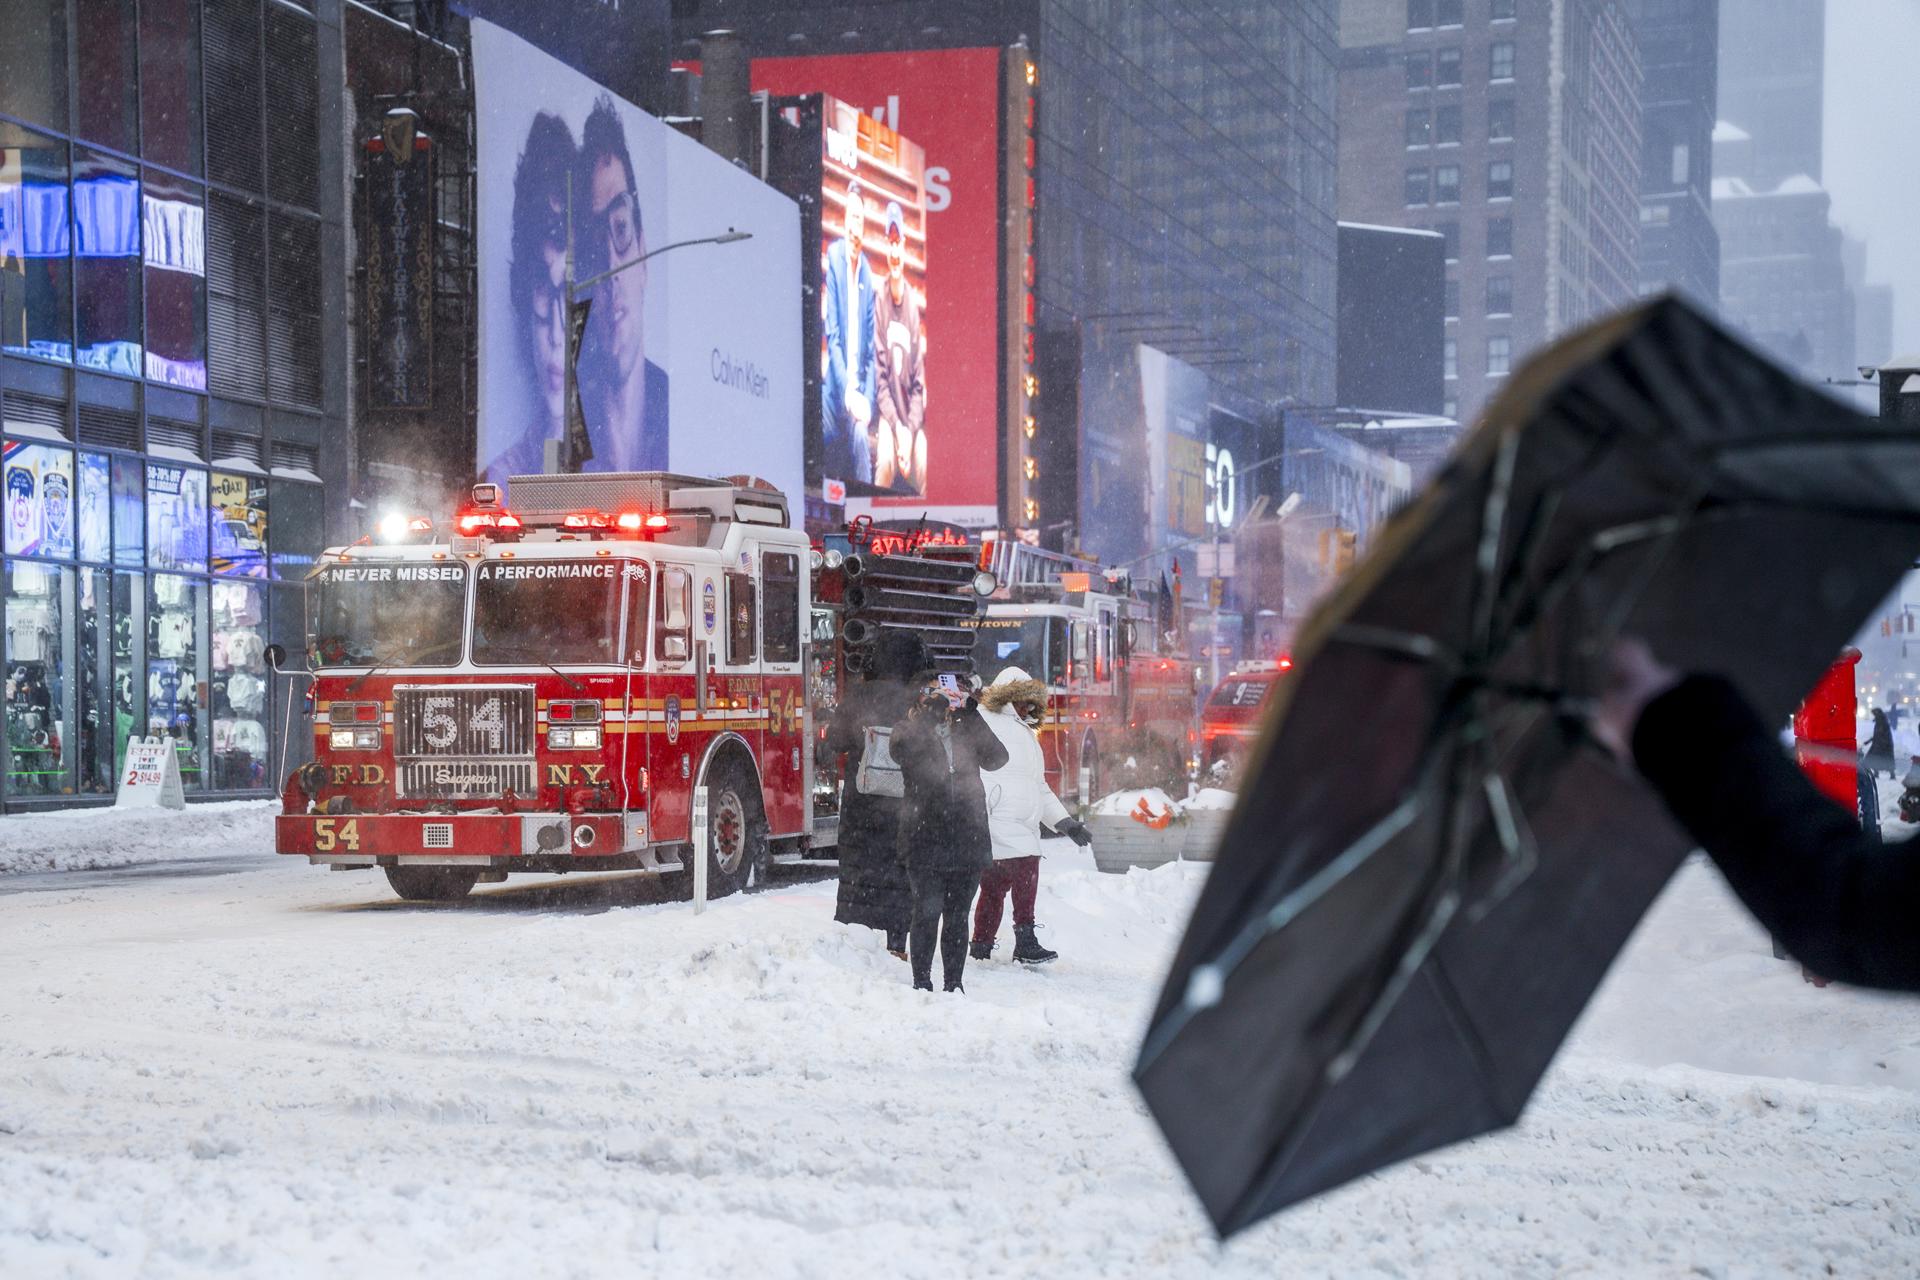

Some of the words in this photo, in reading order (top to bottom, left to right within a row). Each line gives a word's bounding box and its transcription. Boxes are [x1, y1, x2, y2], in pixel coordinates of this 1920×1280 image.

[711, 348, 744, 391] Calvin
[745, 360, 769, 400] Klein
[332, 568, 391, 582] NEVER
[396, 567, 464, 581] MISSED
[479, 567, 490, 580] A
[495, 564, 614, 579] PERFORMANCE
[422, 697, 504, 749] 54
[768, 688, 796, 734] 54
[127, 770, 138, 786] 2
[332, 764, 390, 785] F.D.
[434, 768, 498, 792] Seagrave
[315, 818, 359, 850] 54
